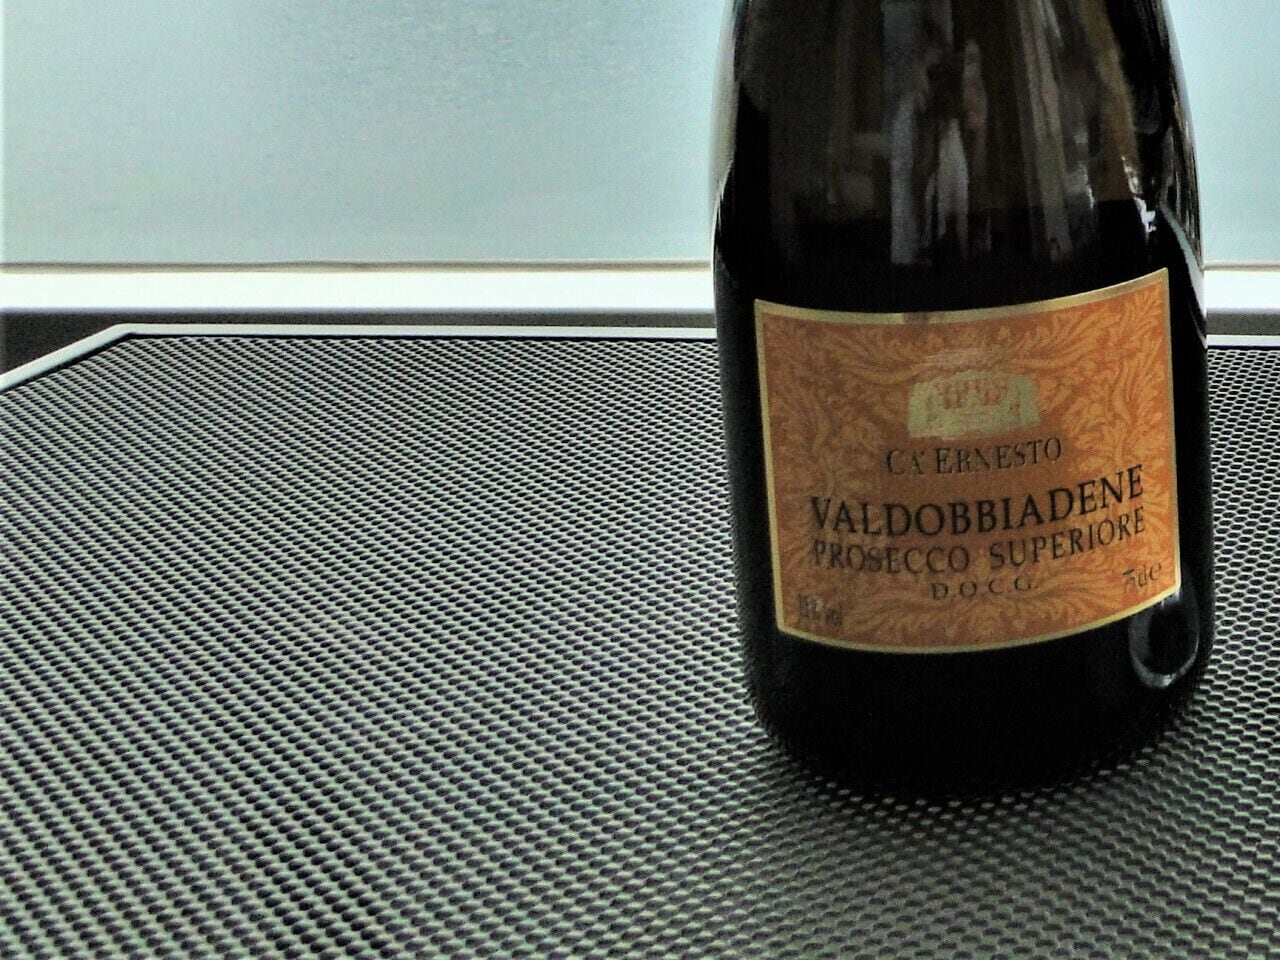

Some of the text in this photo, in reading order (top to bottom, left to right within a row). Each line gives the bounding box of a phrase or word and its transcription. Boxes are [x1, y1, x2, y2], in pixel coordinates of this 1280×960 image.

[935, 436, 1063, 475] ERNESTO
[810, 463, 1144, 538] VALDOBBIADENE
[812, 505, 1145, 575] PROSECCO SUPERIORE
